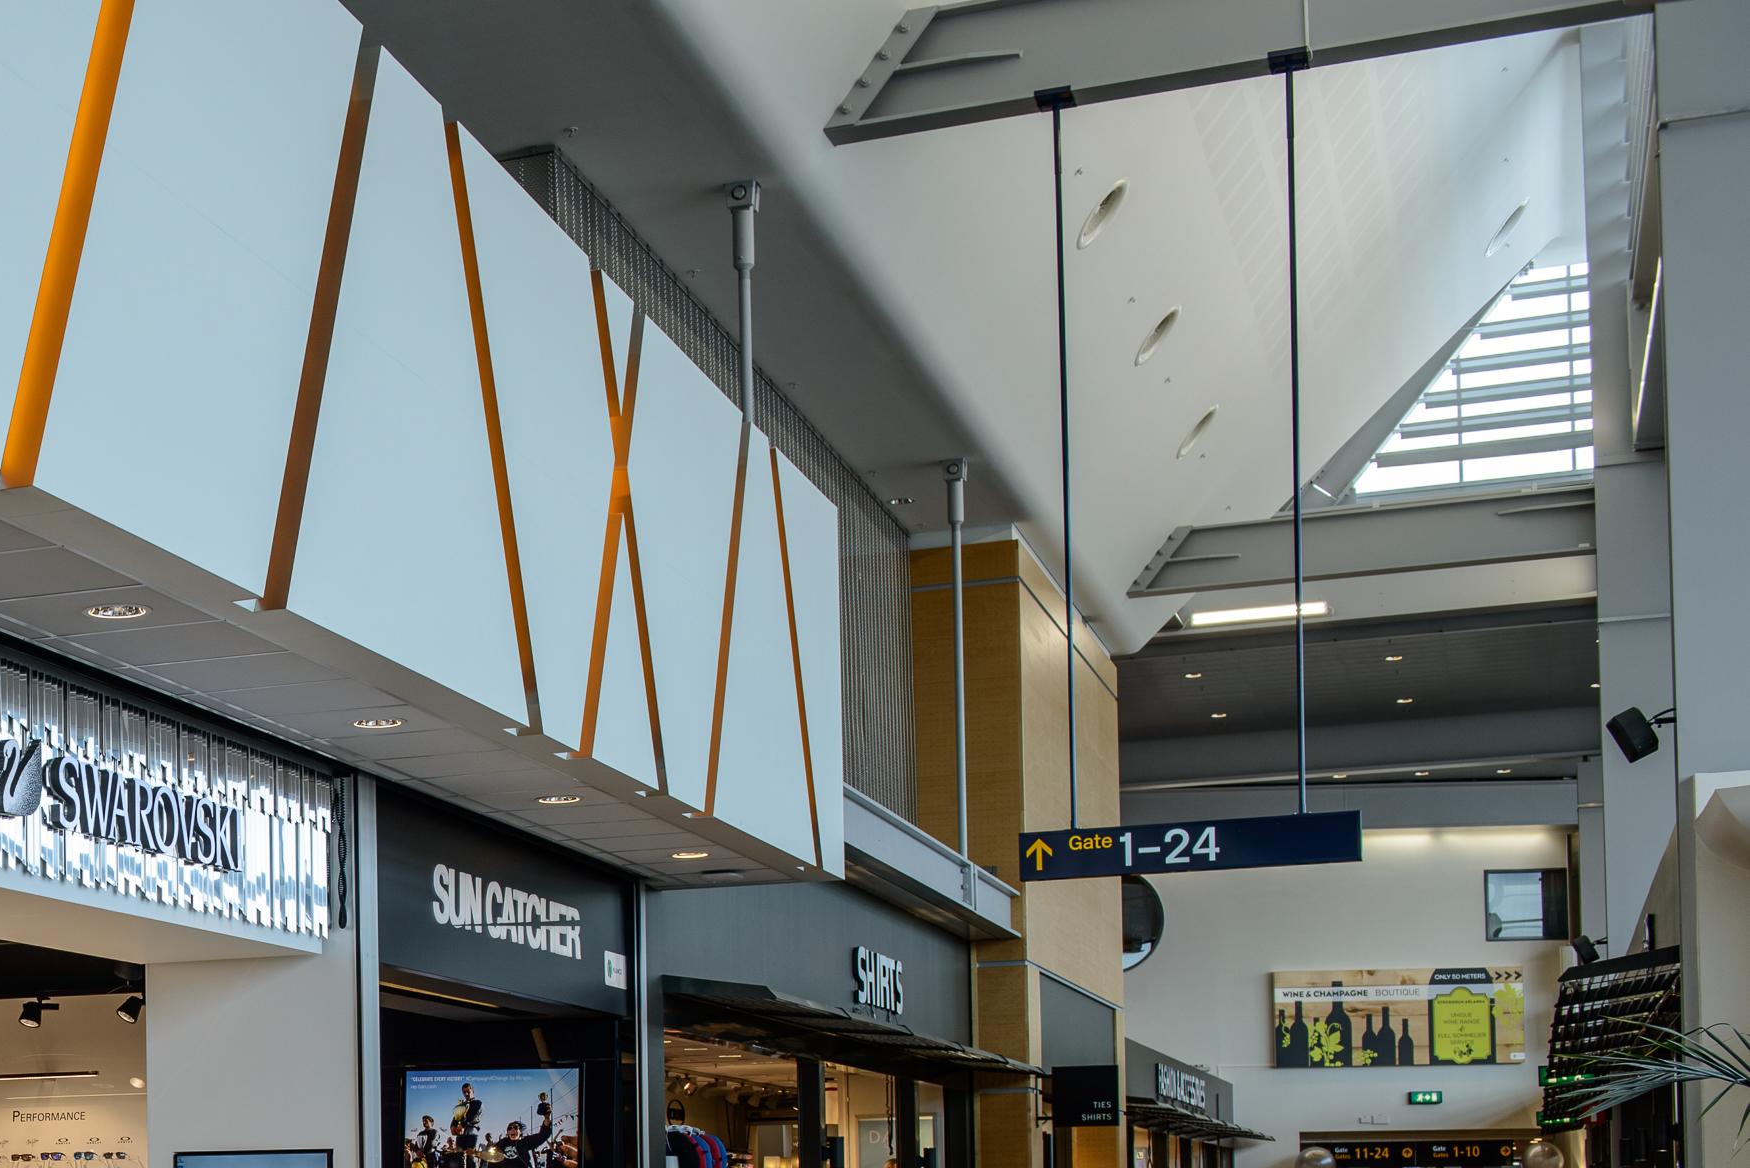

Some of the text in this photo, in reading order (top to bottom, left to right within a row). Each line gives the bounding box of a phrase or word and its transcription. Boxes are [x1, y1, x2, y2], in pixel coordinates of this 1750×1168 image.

[49, 756, 243, 872] SWAROVSKI
[1068, 827, 1220, 867] Gate 1-24
[433, 863, 582, 960] SUN CATCHER
[855, 945, 903, 1015] SHIRTS
[1461, 972, 1486, 980] METERS
[1313, 989, 1369, 998] CHAMPAGNE
[1375, 988, 1420, 997] BOUTIQUE
[1093, 1101, 1112, 1109] TIES
[12, 1110, 86, 1122] PERFORMANCE
[1081, 1113, 1112, 1121] SHIRTS
[1355, 1147, 1389, 1160] 11-24
[1453, 1146, 1480, 1158] 1-10
